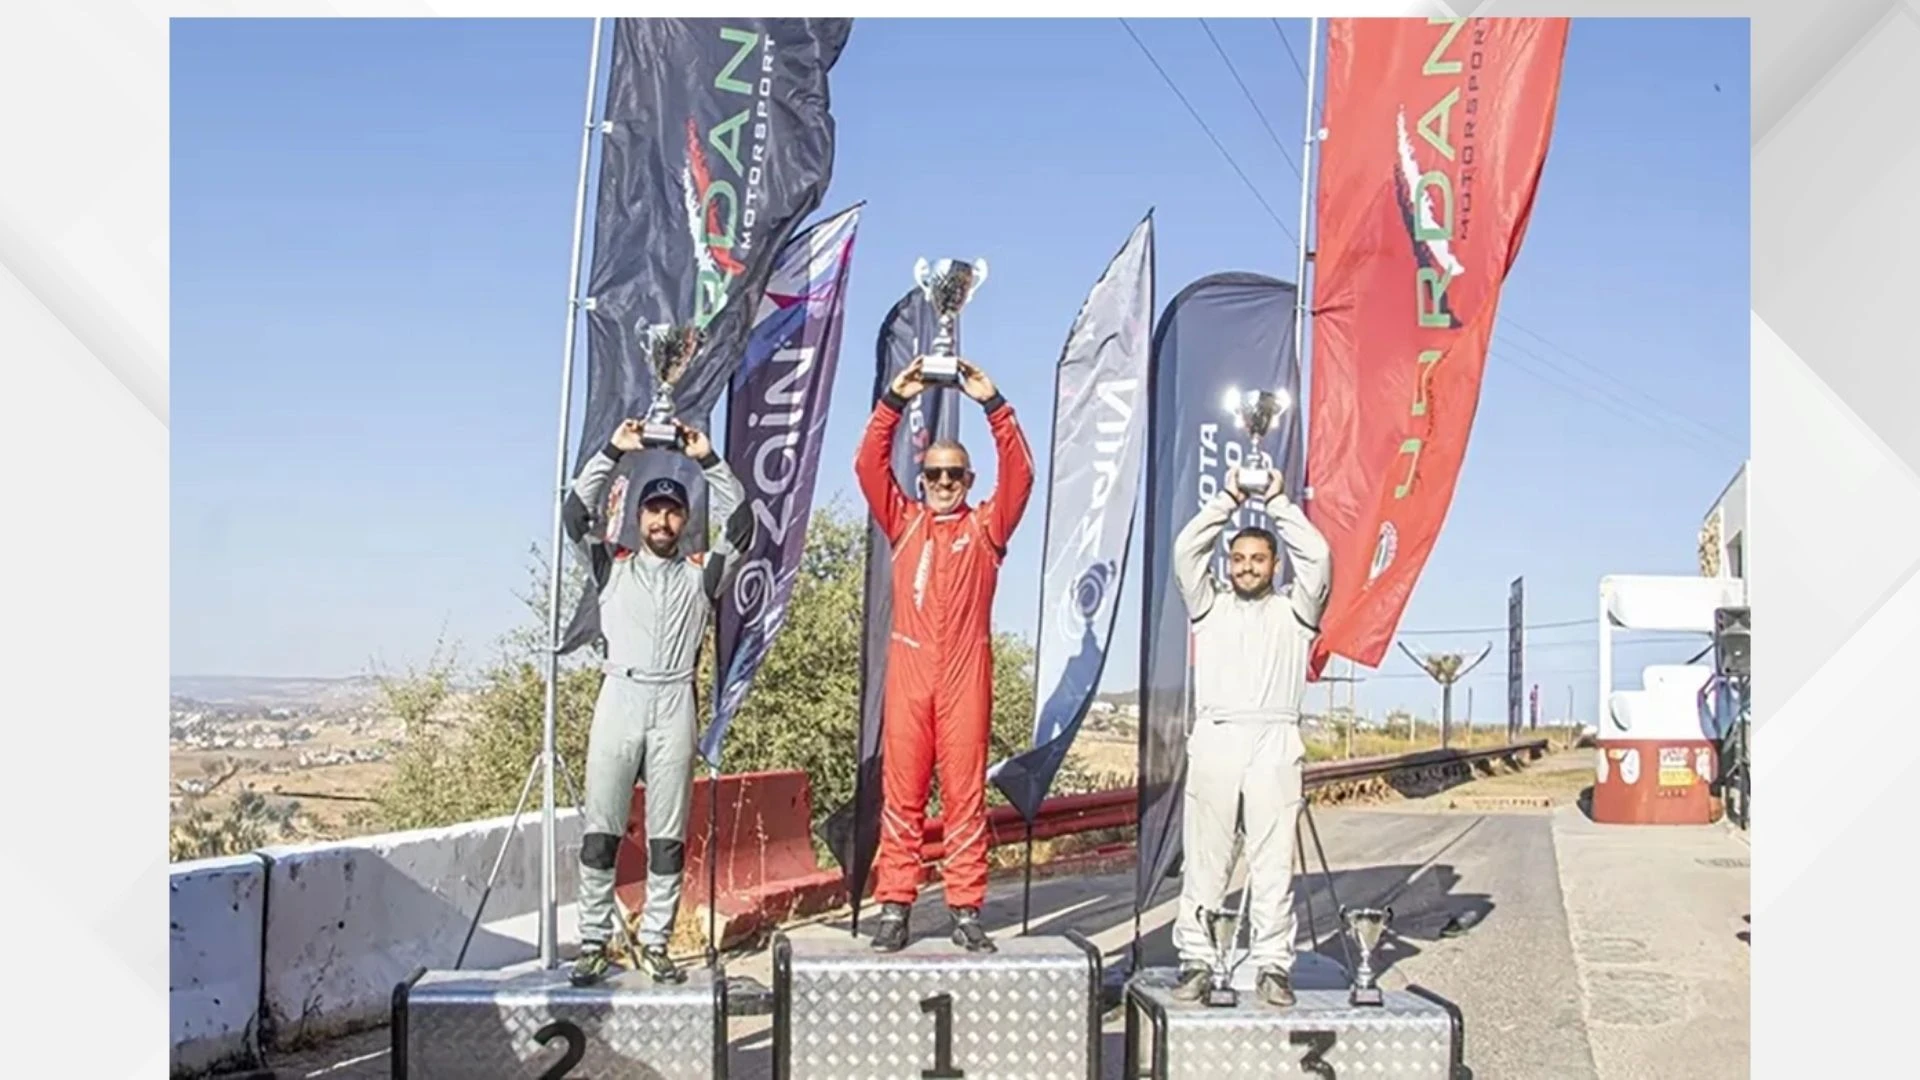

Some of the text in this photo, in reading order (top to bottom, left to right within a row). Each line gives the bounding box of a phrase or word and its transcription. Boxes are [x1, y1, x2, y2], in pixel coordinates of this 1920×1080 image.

[740, 34, 776, 249] MOTORSPORT
[533, 1019, 587, 1080] 2
[920, 993, 964, 1078] 1
[1289, 1030, 1337, 1080] 3
